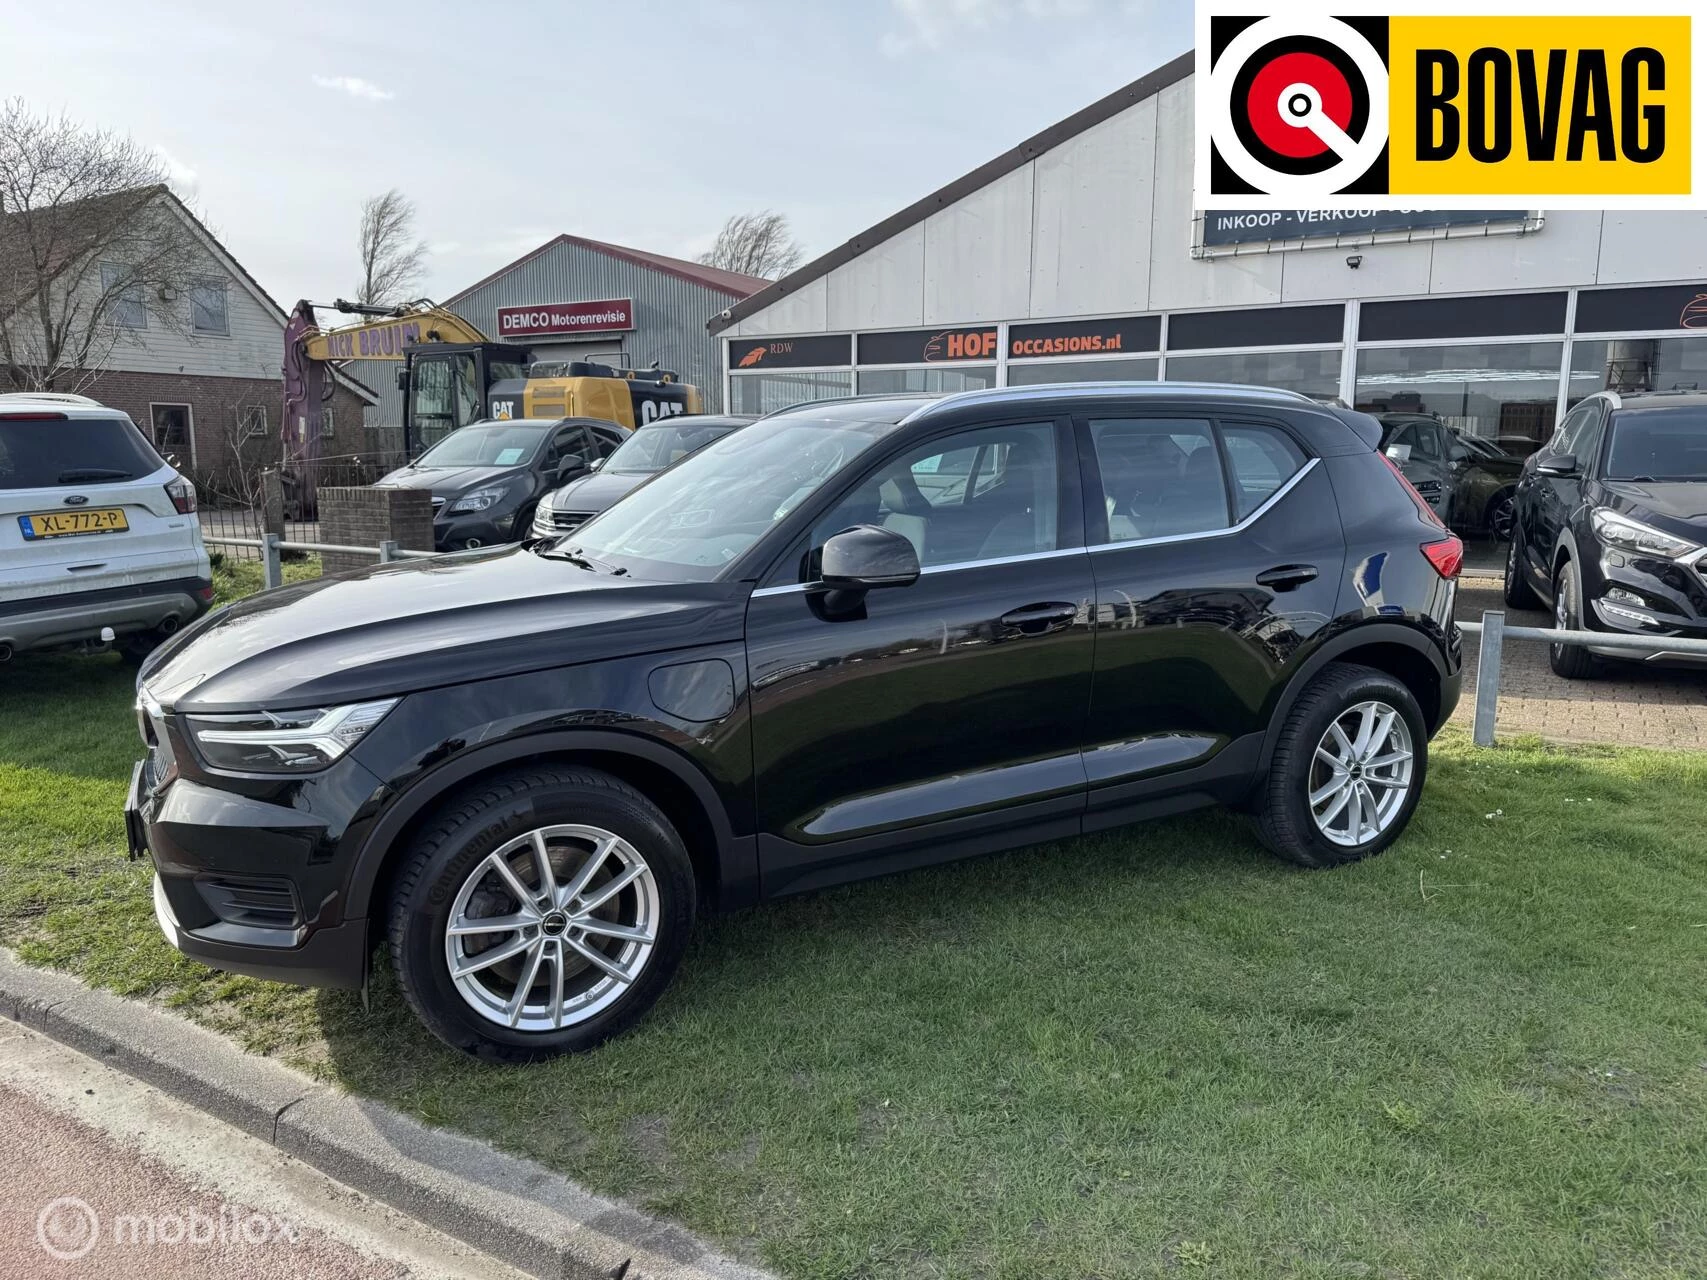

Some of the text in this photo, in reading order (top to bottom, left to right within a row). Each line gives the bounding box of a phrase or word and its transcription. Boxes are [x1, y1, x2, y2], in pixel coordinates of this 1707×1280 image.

[1217, 212, 1282, 230] INKOOP
[503, 310, 626, 329] DEMCO Motorenrevisie
[770, 343, 793, 354] RDW
[947, 332, 1121, 357] HOF OCCASIONS.nl
[492, 400, 514, 420] CAT
[40, 513, 117, 531] XL-772-P
